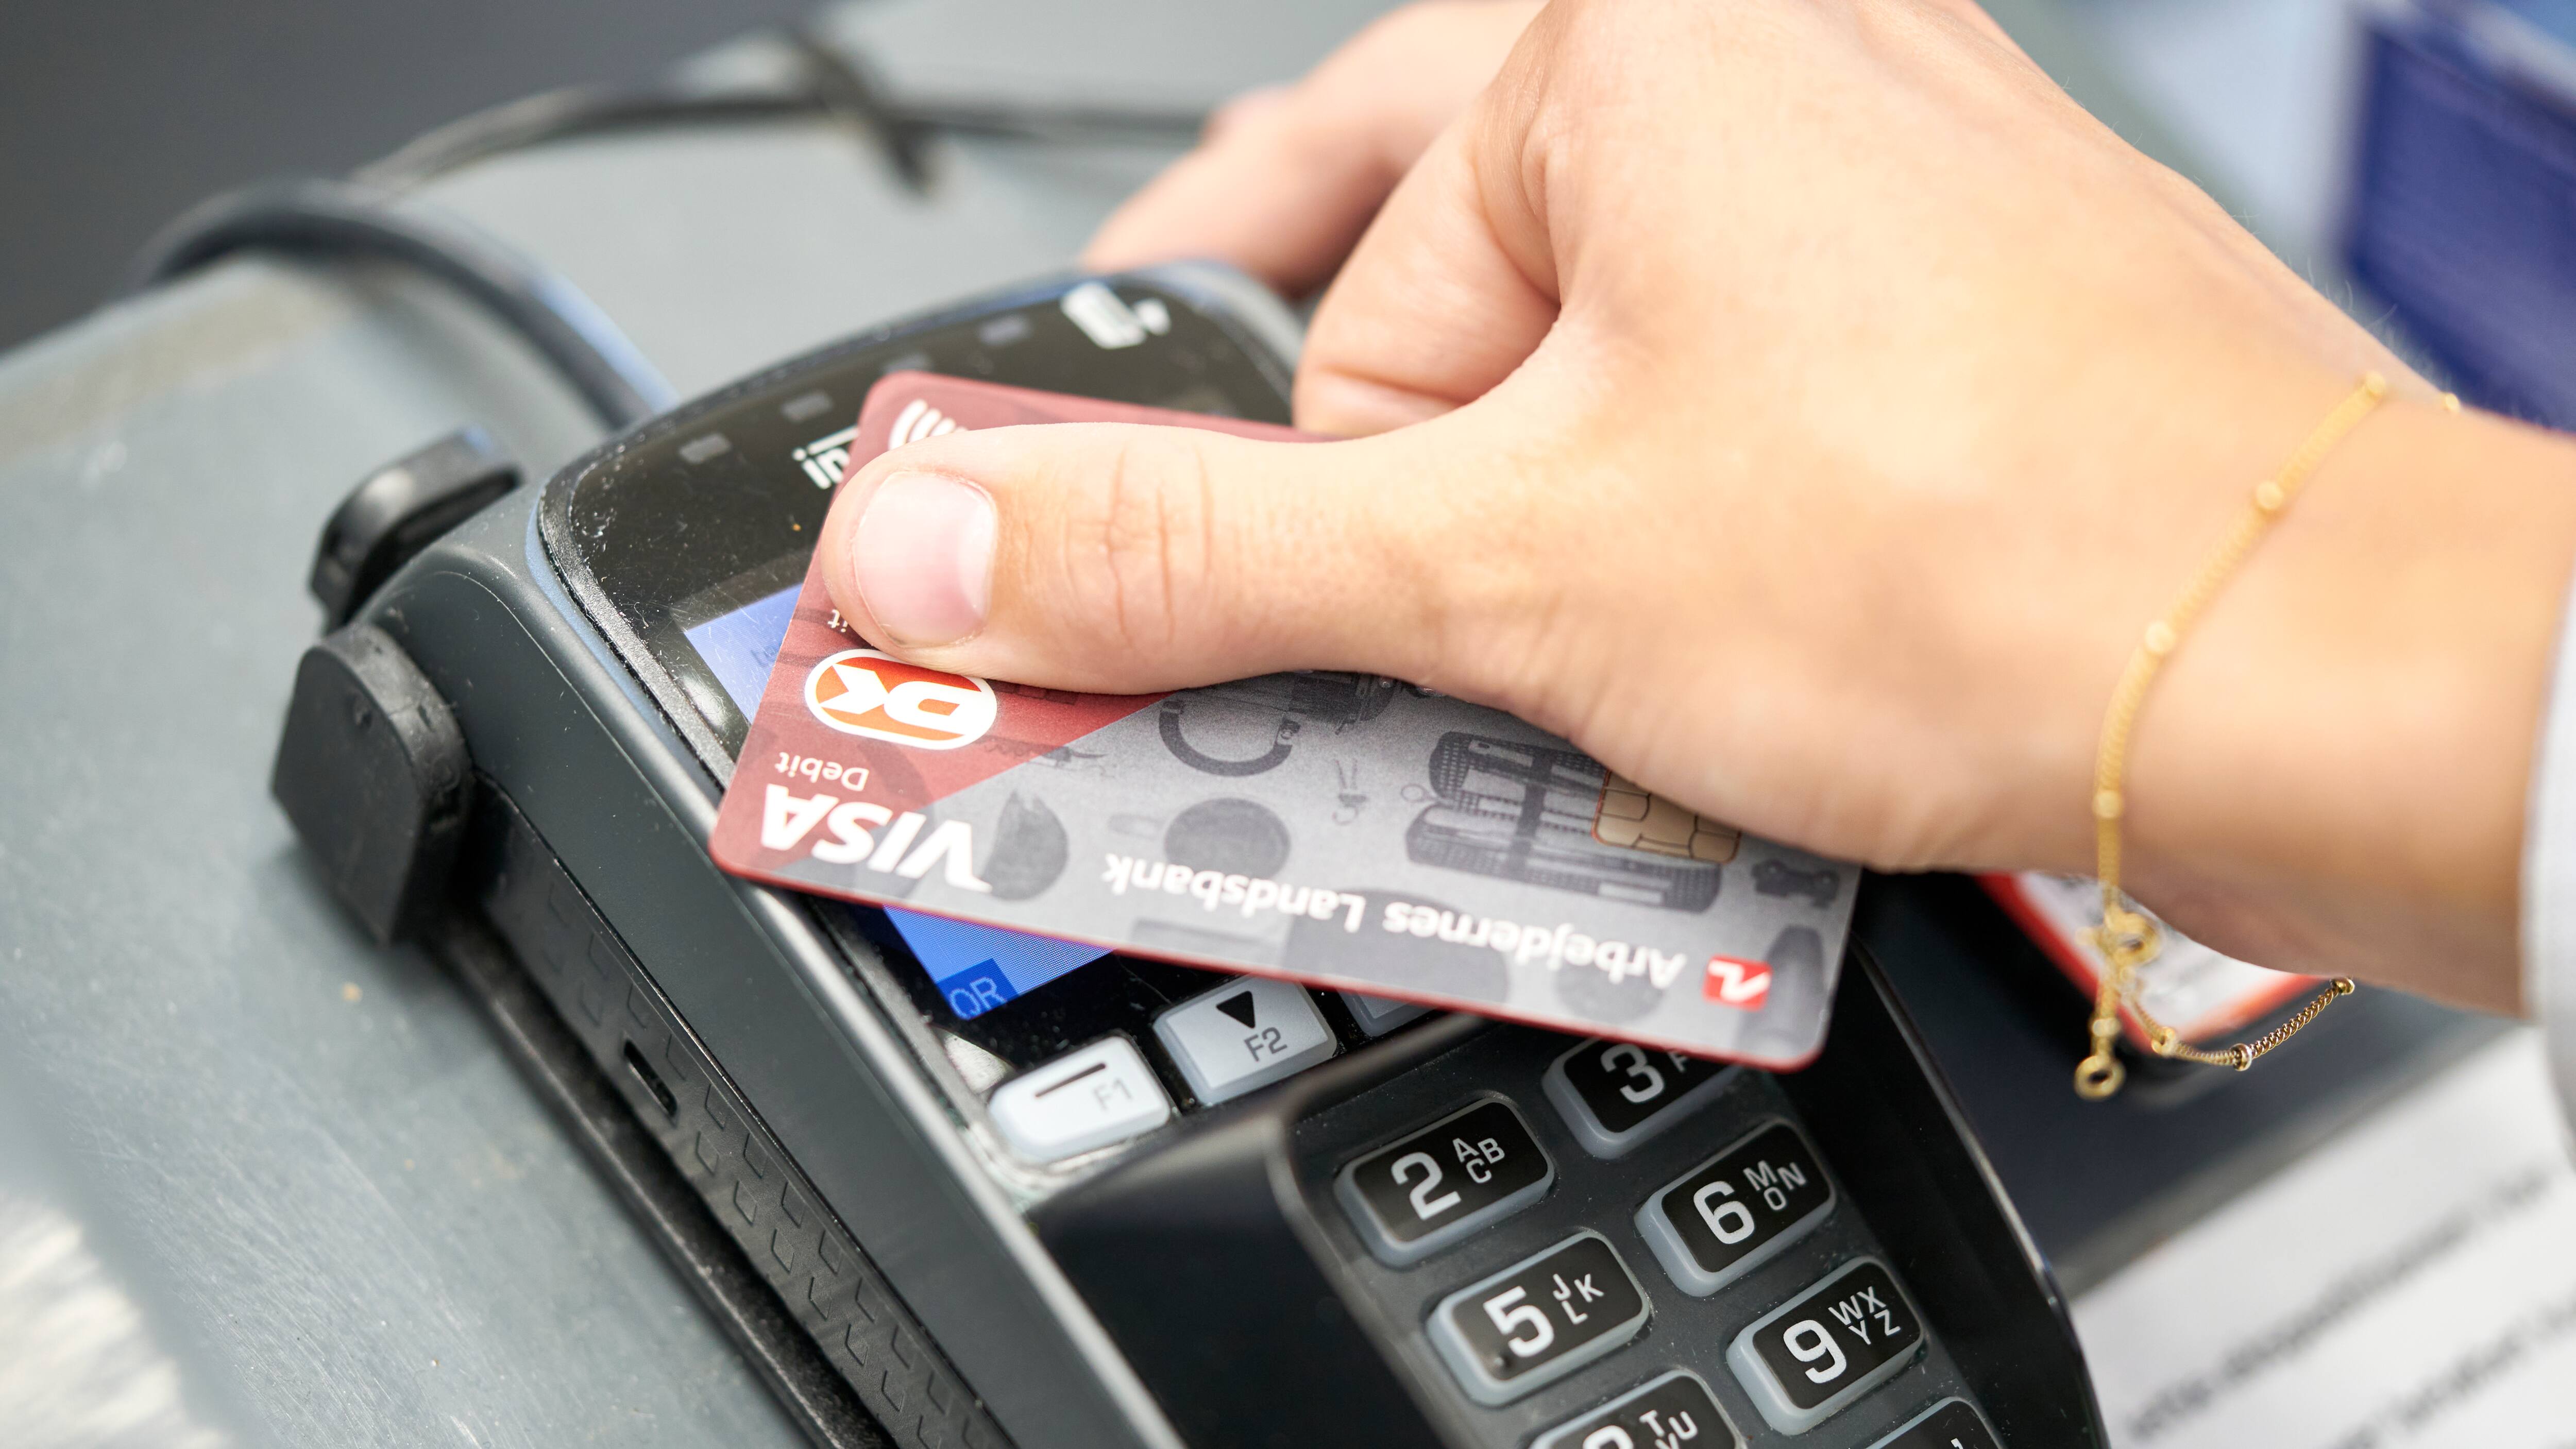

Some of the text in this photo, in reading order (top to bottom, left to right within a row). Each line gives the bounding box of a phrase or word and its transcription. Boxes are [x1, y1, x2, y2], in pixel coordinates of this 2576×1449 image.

[816, 660, 985, 740] DK
[775, 752, 869, 792] Debit
[760, 783, 992, 893] VISA
[1101, 853, 1687, 988] Arbejdernes Landsbank
[1244, 1027, 1288, 1062] F2
[1600, 1043, 1665, 1103] 3
[1091, 1078, 1132, 1111] F1
[1391, 1152, 1461, 1221] 2
[1693, 1180, 1755, 1245] 6
[1483, 1286, 1555, 1360] 5
[1783, 1319, 1847, 1385] 9
